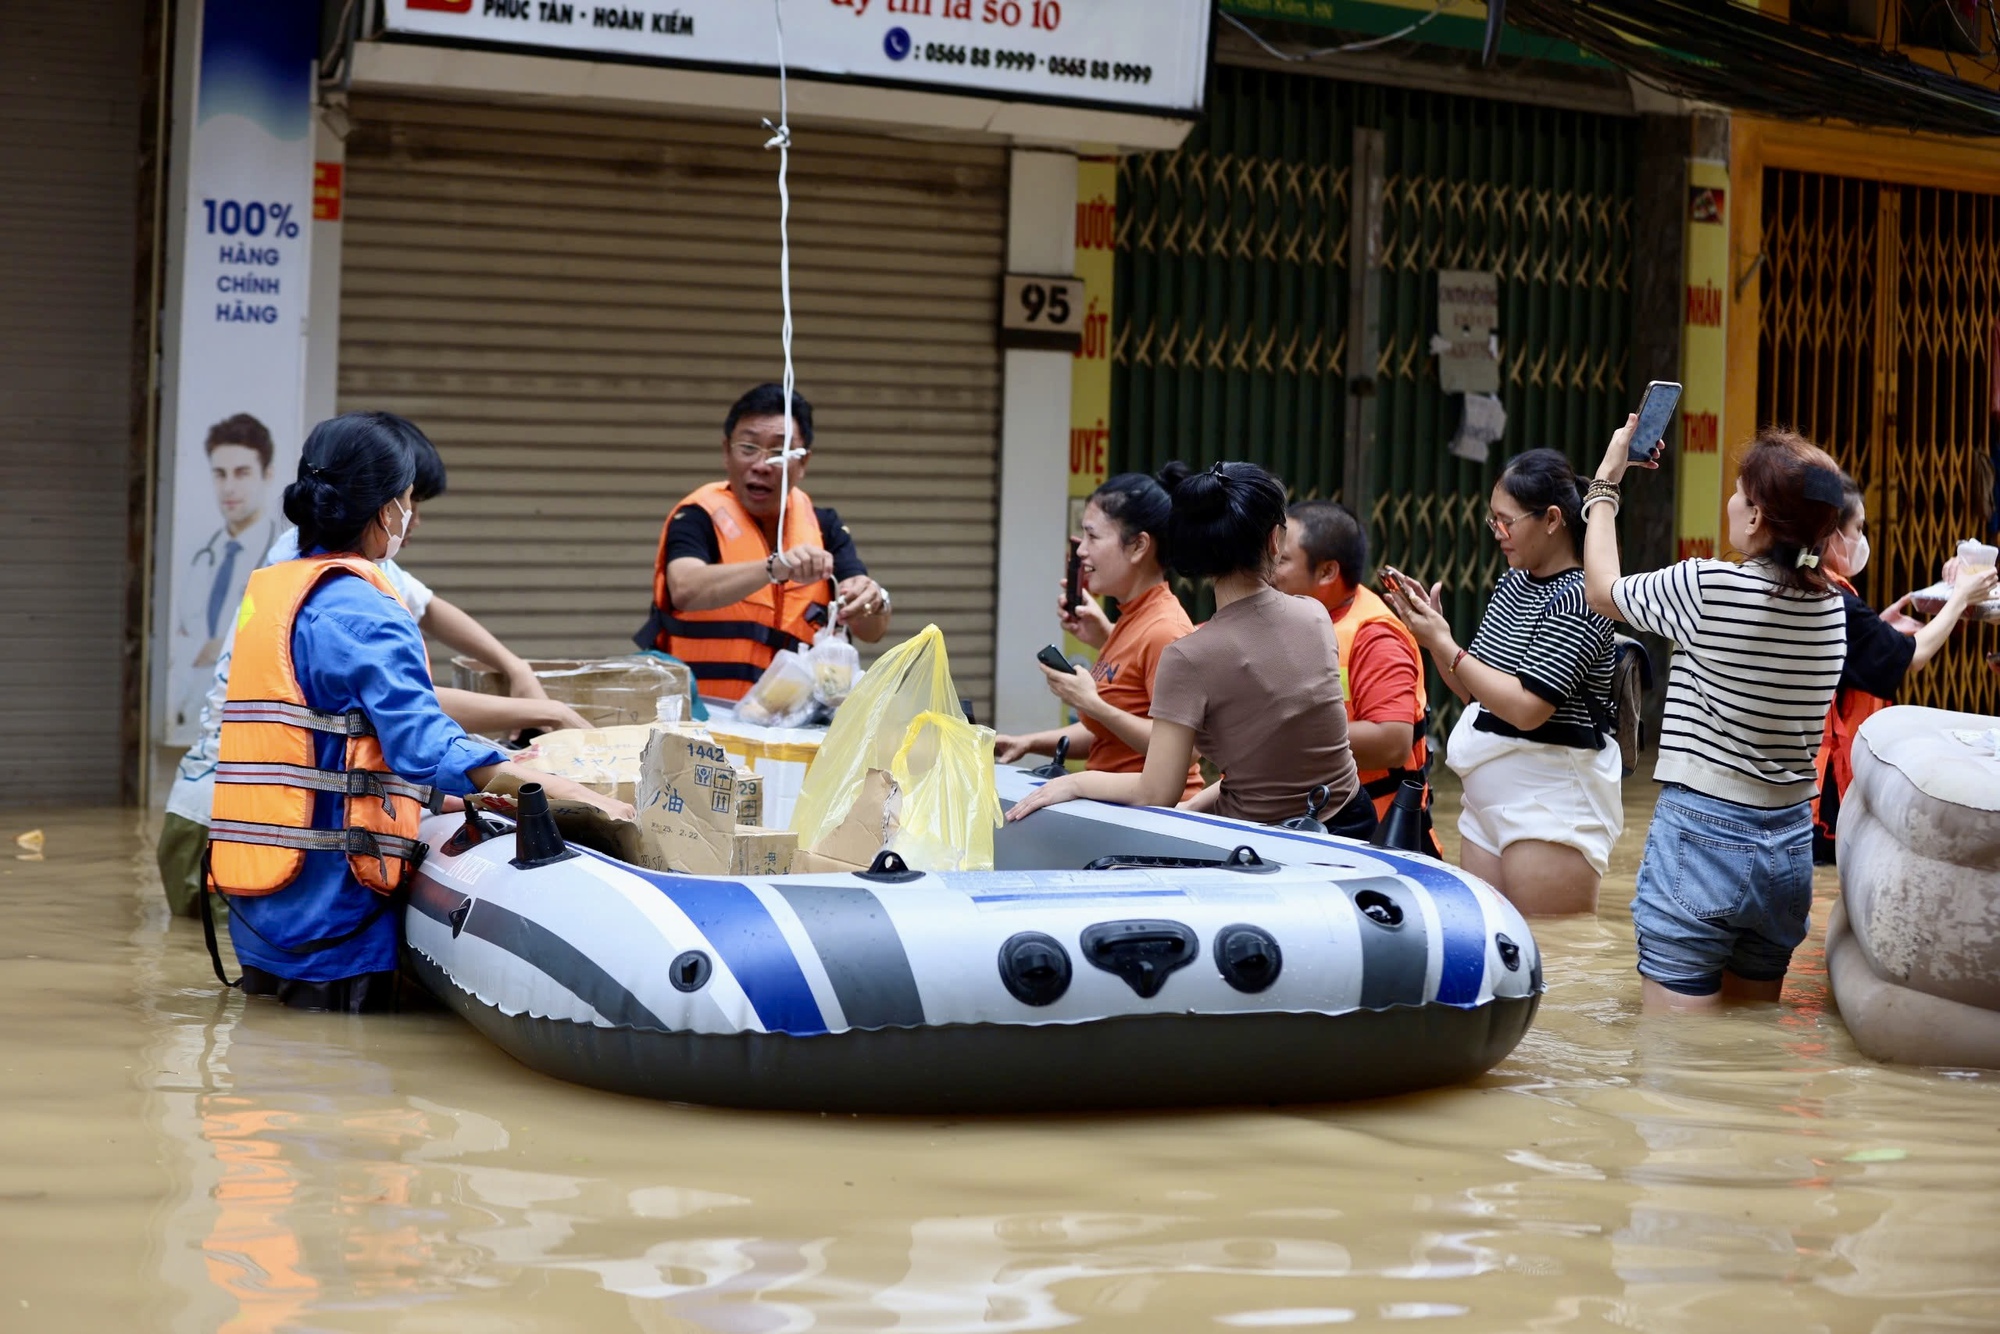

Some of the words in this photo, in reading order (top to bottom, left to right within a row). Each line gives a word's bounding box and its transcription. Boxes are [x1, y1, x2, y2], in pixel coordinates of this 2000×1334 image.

[1031, 0, 1061, 31] 10
[925, 42, 966, 65] 0566
[969, 47, 990, 67] 88
[995, 49, 1036, 72] 9999
[1047, 55, 1086, 78] 0565
[1090, 60, 1110, 80] 88
[1113, 61, 1152, 84] 9999
[203, 199, 300, 240] 100%
[219, 242, 280, 266] HÀNG
[216, 271, 280, 295] CHÍNH
[1020, 283, 1071, 324] 95
[687, 743, 725, 763] 1442
